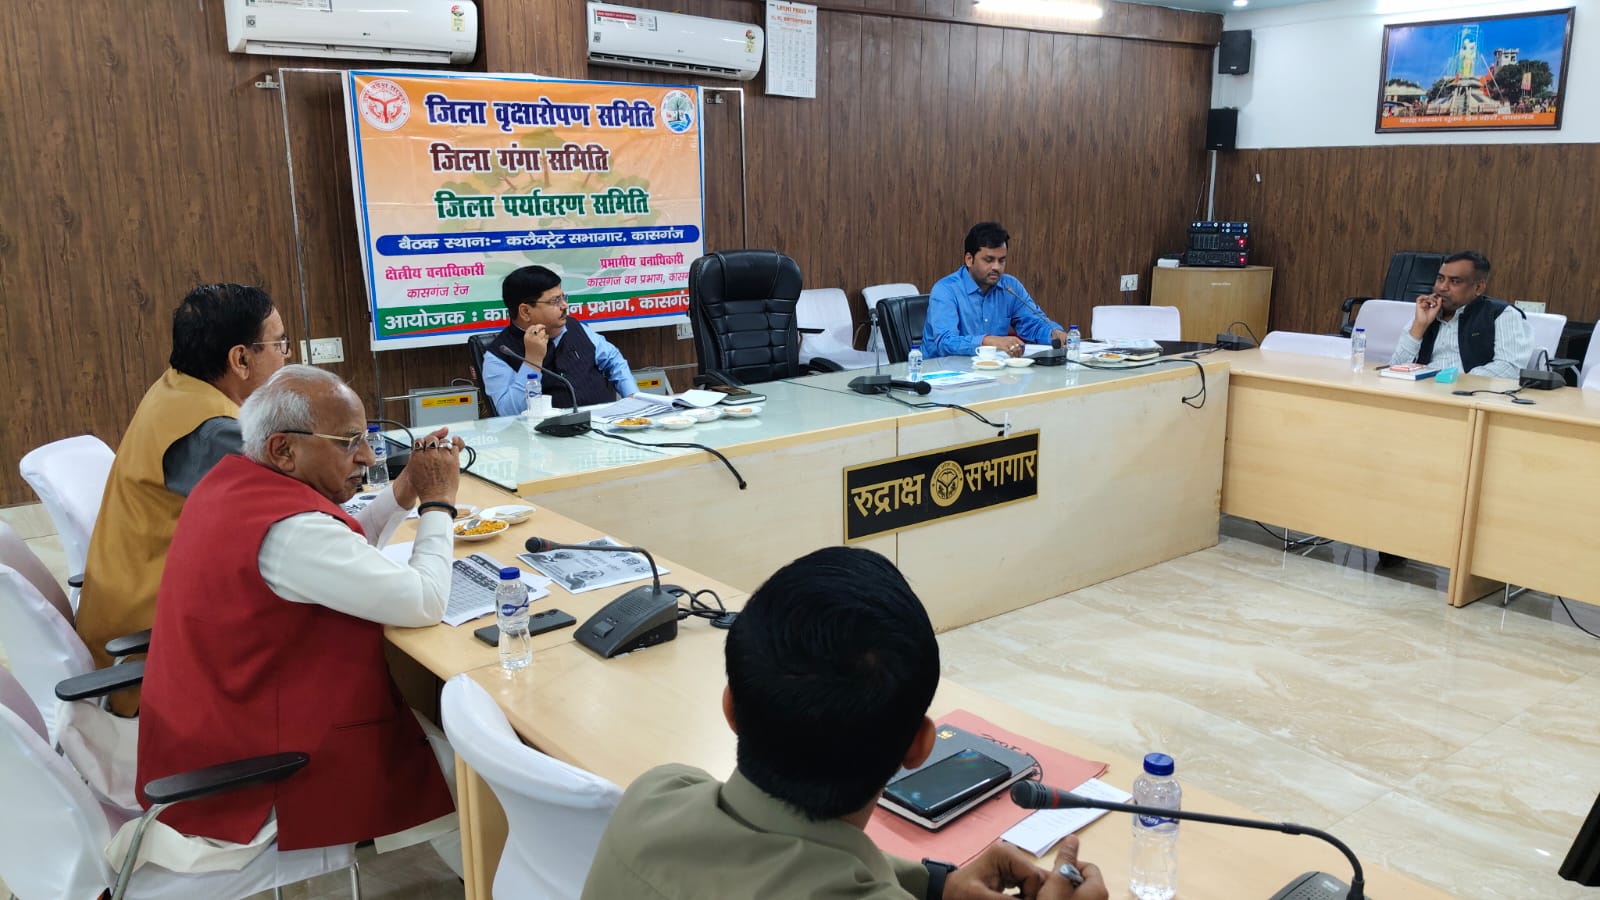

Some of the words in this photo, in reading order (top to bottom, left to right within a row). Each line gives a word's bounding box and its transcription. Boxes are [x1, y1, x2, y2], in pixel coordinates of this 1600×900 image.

[425, 94, 486, 124] जिला
[493, 98, 590, 131] वृक्षारोपण
[596, 100, 655, 127] समिति
[430, 143, 491, 171] जिला
[497, 143, 540, 171] गंगा
[547, 144, 609, 171] समिति
[434, 190, 495, 218] जिला
[501, 189, 585, 217] पर्यावरण
[591, 188, 649, 214] समिति
[398, 235, 438, 250] बैठक
[569, 231, 627, 244] सभागार,
[631, 227, 684, 241] कासगंज
[426, 262, 485, 278] वनाधिकारी
[600, 254, 636, 269] प्रभागीय
[640, 252, 684, 267] वनाधिकारी
[407, 283, 450, 299] कासगंज
[624, 275, 637, 286] वन
[384, 309, 466, 331] आयोजक
[587, 298, 636, 317] प्रभाग,
[851, 473, 925, 517] रुद्राक्ष
[963, 450, 1037, 493] सभागार
